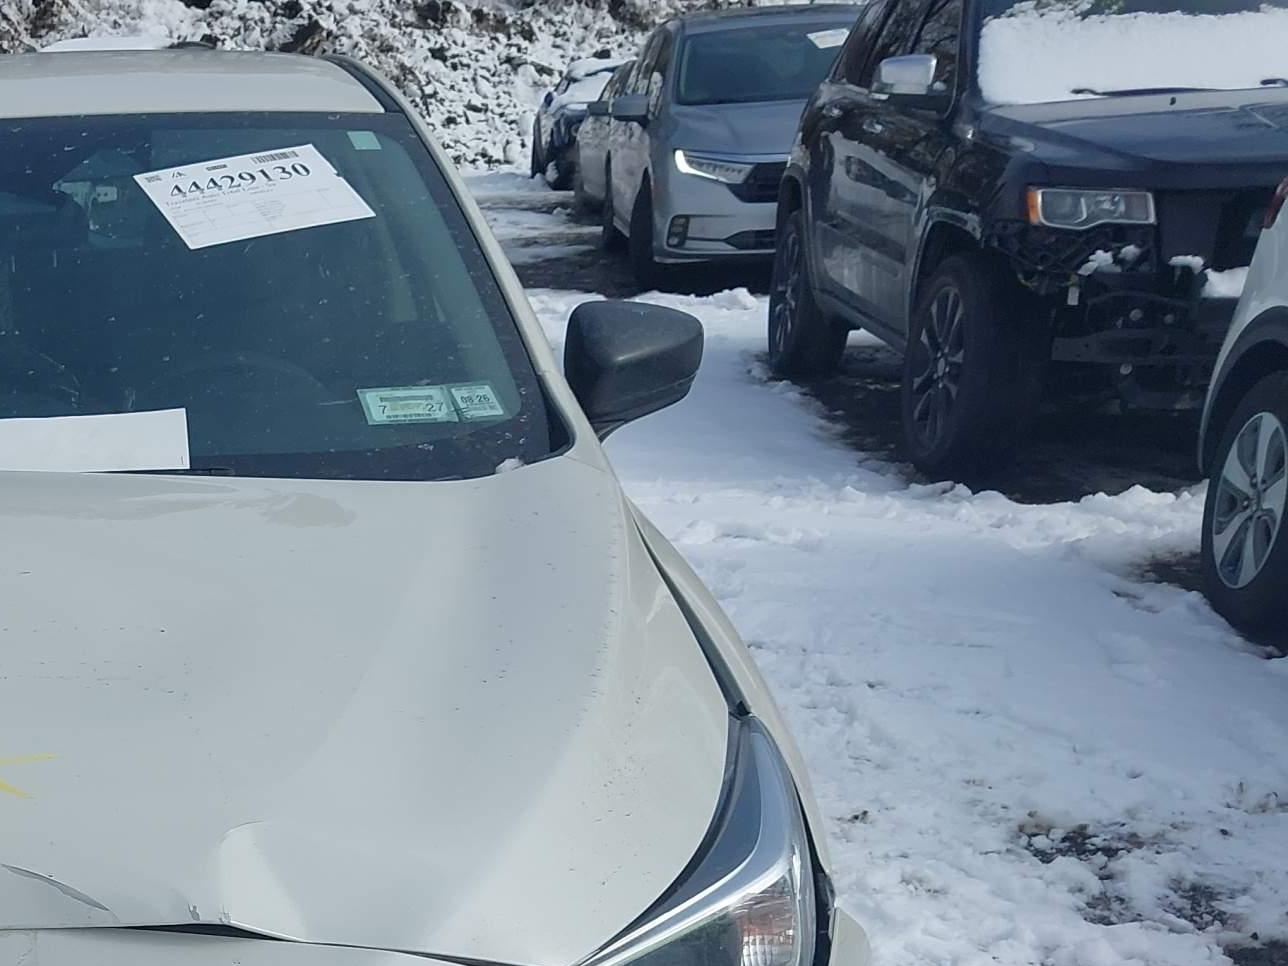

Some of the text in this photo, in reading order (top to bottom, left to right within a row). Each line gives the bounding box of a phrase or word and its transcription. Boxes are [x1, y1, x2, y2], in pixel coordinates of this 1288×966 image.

[171, 162, 311, 198] 44429130
[377, 402, 444, 415] 7 27
